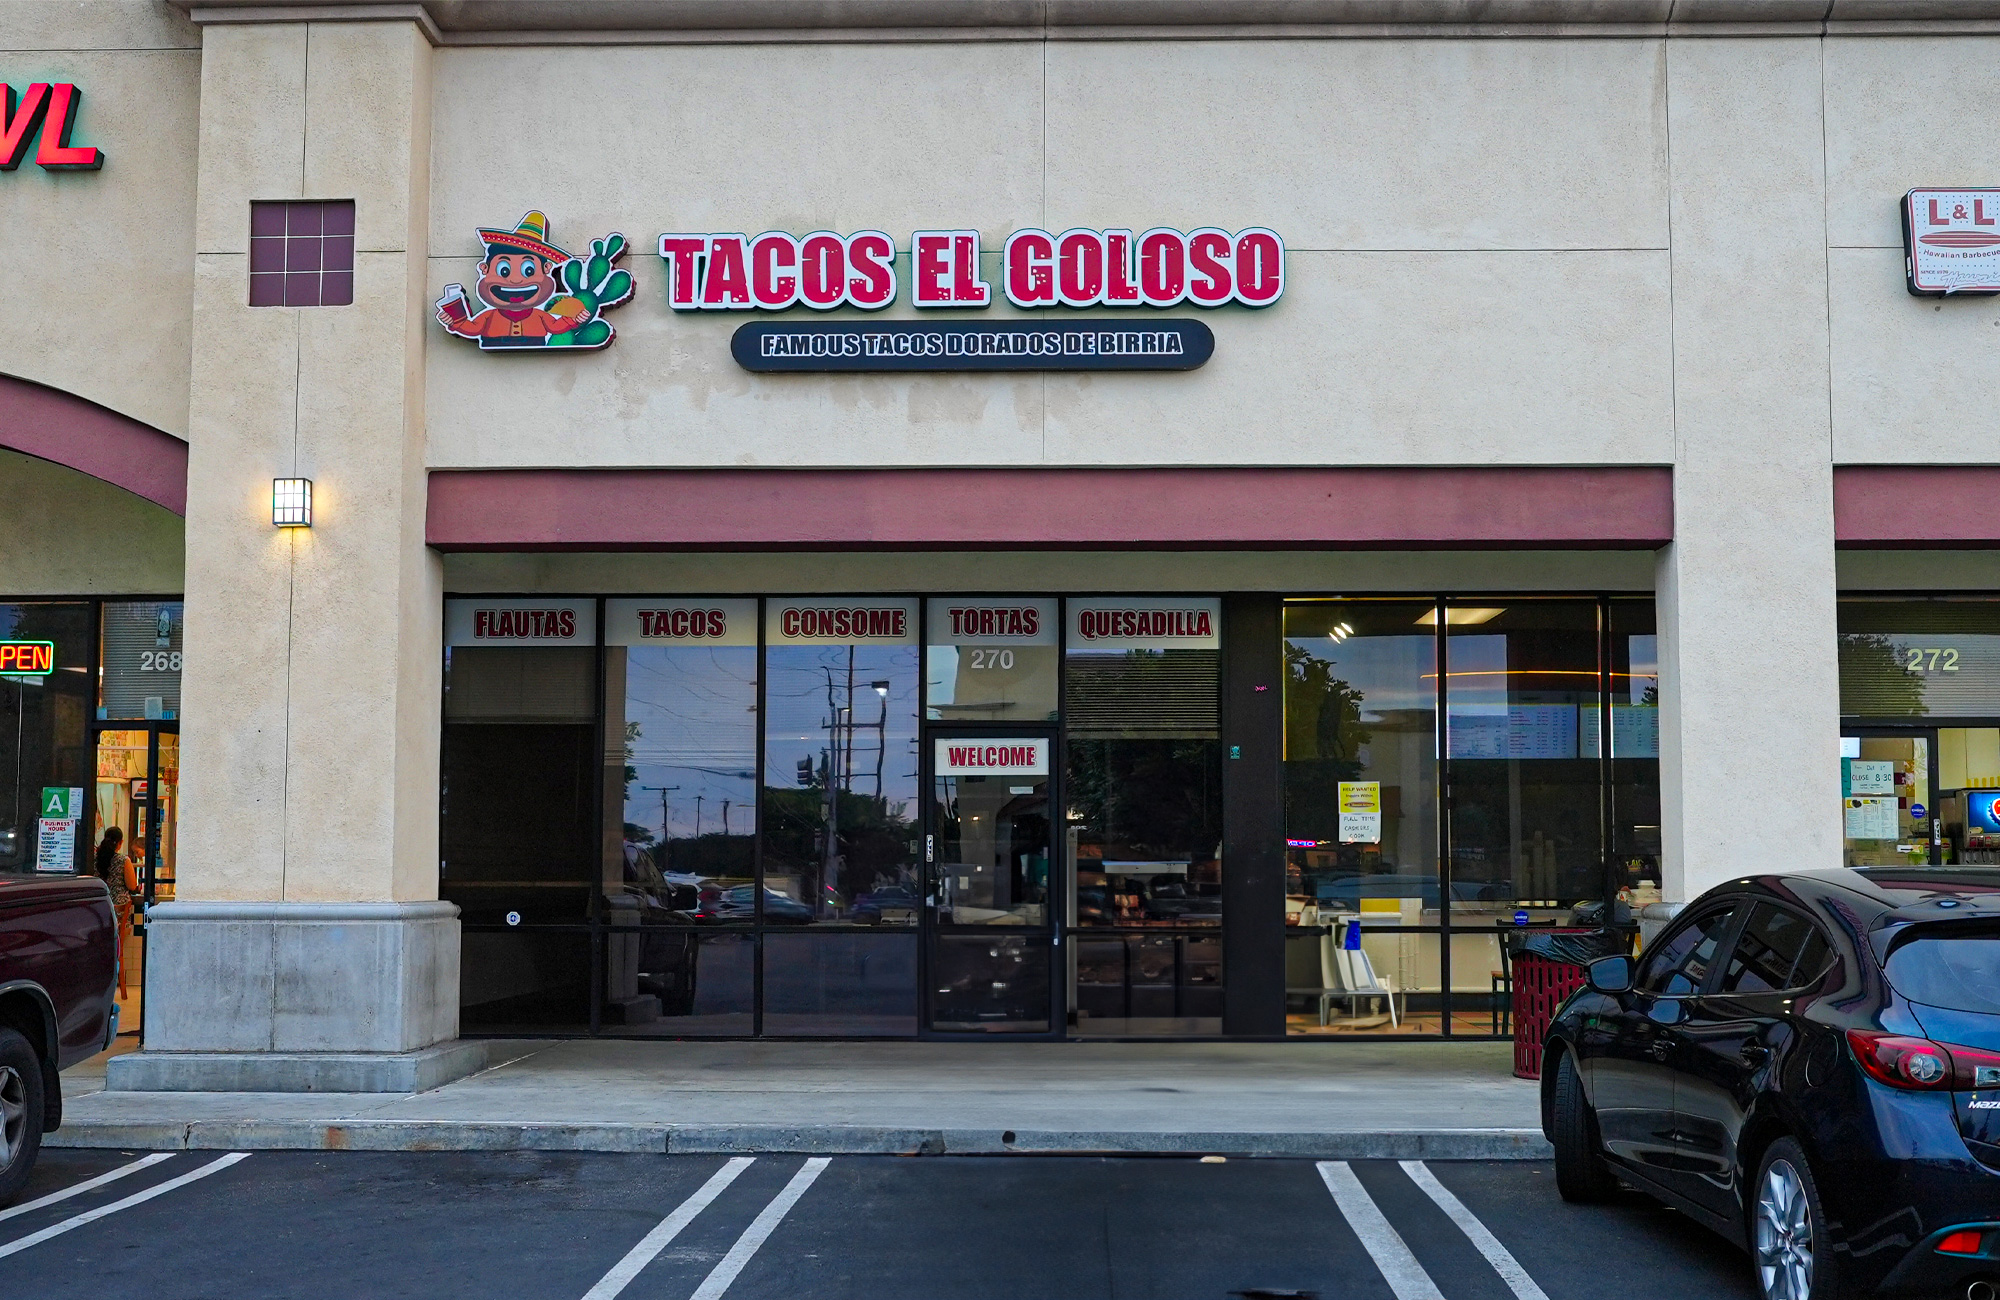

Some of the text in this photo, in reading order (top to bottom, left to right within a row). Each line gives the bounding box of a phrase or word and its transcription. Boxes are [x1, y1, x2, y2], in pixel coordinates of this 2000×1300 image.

[1923, 249, 1961, 259] Hawaiian
[661, 230, 1282, 308] TACOS EL GOLOSO
[761, 332, 1184, 357] FAMOUS TACOS DORADOS DE BIRRIA
[474, 608, 577, 639] FLAUTAS
[637, 608, 727, 639] TACOS
[780, 606, 907, 638] CONSOME
[947, 606, 1040, 637] TORTAS
[1077, 608, 1214, 640] QUESADILLA
[140, 651, 182, 671] 268
[970, 649, 1014, 670] 270
[1907, 648, 1959, 671] 272
[948, 745, 1038, 768] WELCOME
[46, 794, 64, 813] A
